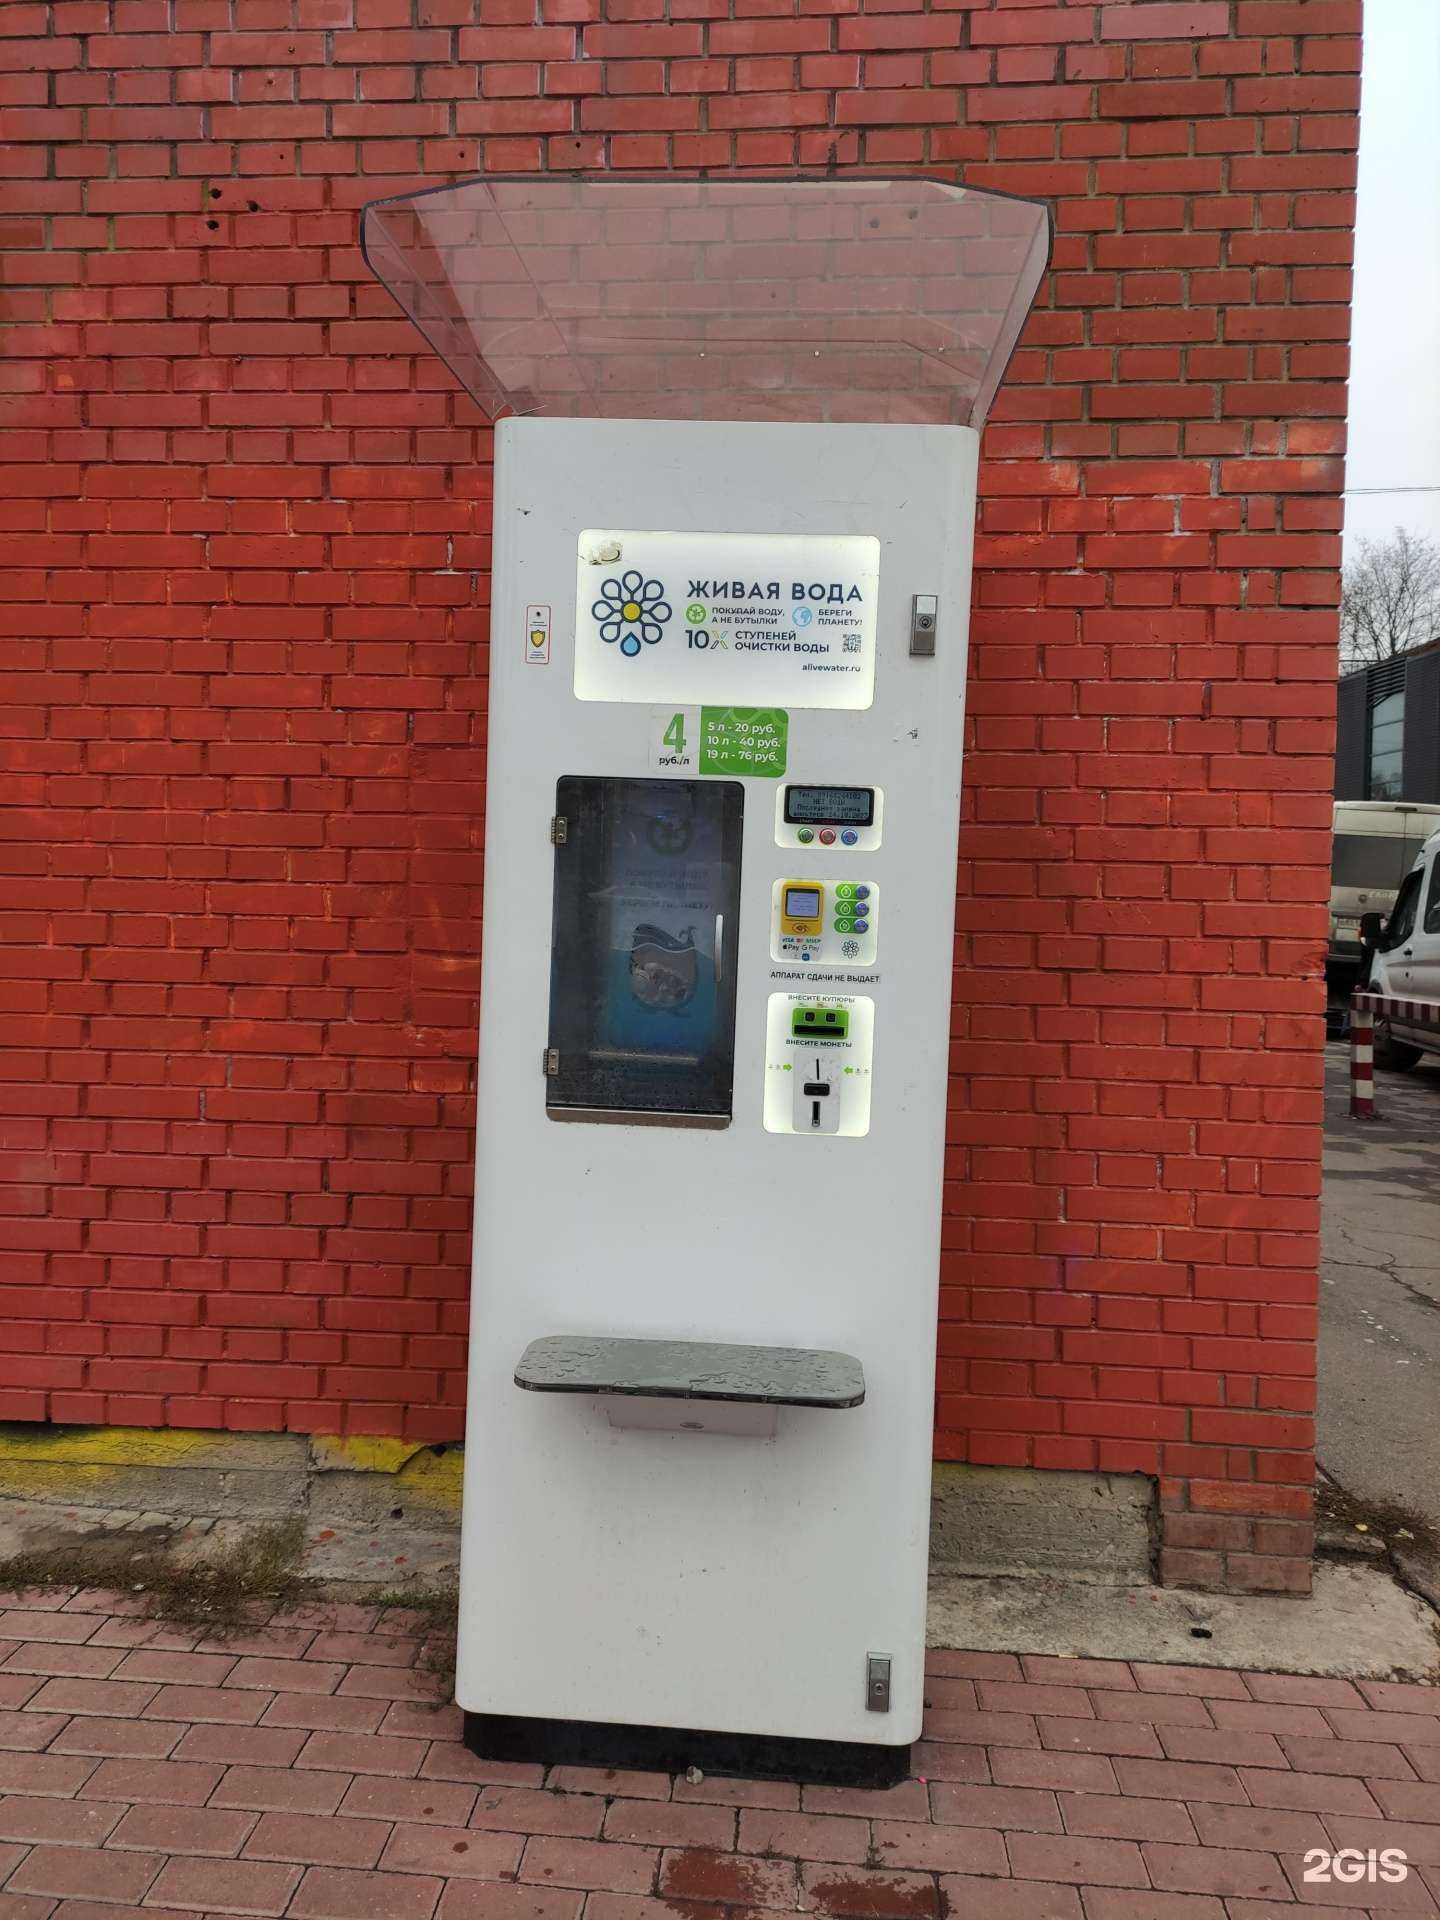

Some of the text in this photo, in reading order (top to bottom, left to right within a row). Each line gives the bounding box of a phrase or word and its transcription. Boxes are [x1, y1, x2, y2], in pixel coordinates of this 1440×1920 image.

[687, 580, 863, 604] ЖИВАЯ ВОДА
[712, 606, 785, 617] ПОКУПАЙ ВОДУ,
[818, 608, 852, 617] БЕРЕГИ
[712, 616, 778, 625] А НЕ БУТЫЛКИ
[817, 618, 863, 626] ПЛАНЕТУ!
[735, 630, 797, 641] СТУПЕНЕЙ
[735, 642, 830, 654] ОЧИСТКИ ВОДЫ
[802, 663, 861, 672] alivewater.ru
[663, 713, 687, 754] 4
[707, 722, 715, 731] 5
[717, 723, 725, 731] л
[735, 723, 749, 732] 20
[752, 723, 776, 736] руб.
[707, 736, 719, 745] 10
[721, 737, 729, 745] л
[739, 737, 755, 746] 40
[757, 738, 781, 749] руб.
[659, 756, 690, 766] руб./л
[706, 749, 718, 759] 19
[720, 751, 729, 759] л
[739, 751, 752, 760] 76
[754, 751, 778, 762] руб.
[770, 971, 805, 980] АППАРАТ
[807, 973, 833, 982] СДАЧИ
[835, 974, 845, 982] НЕ
